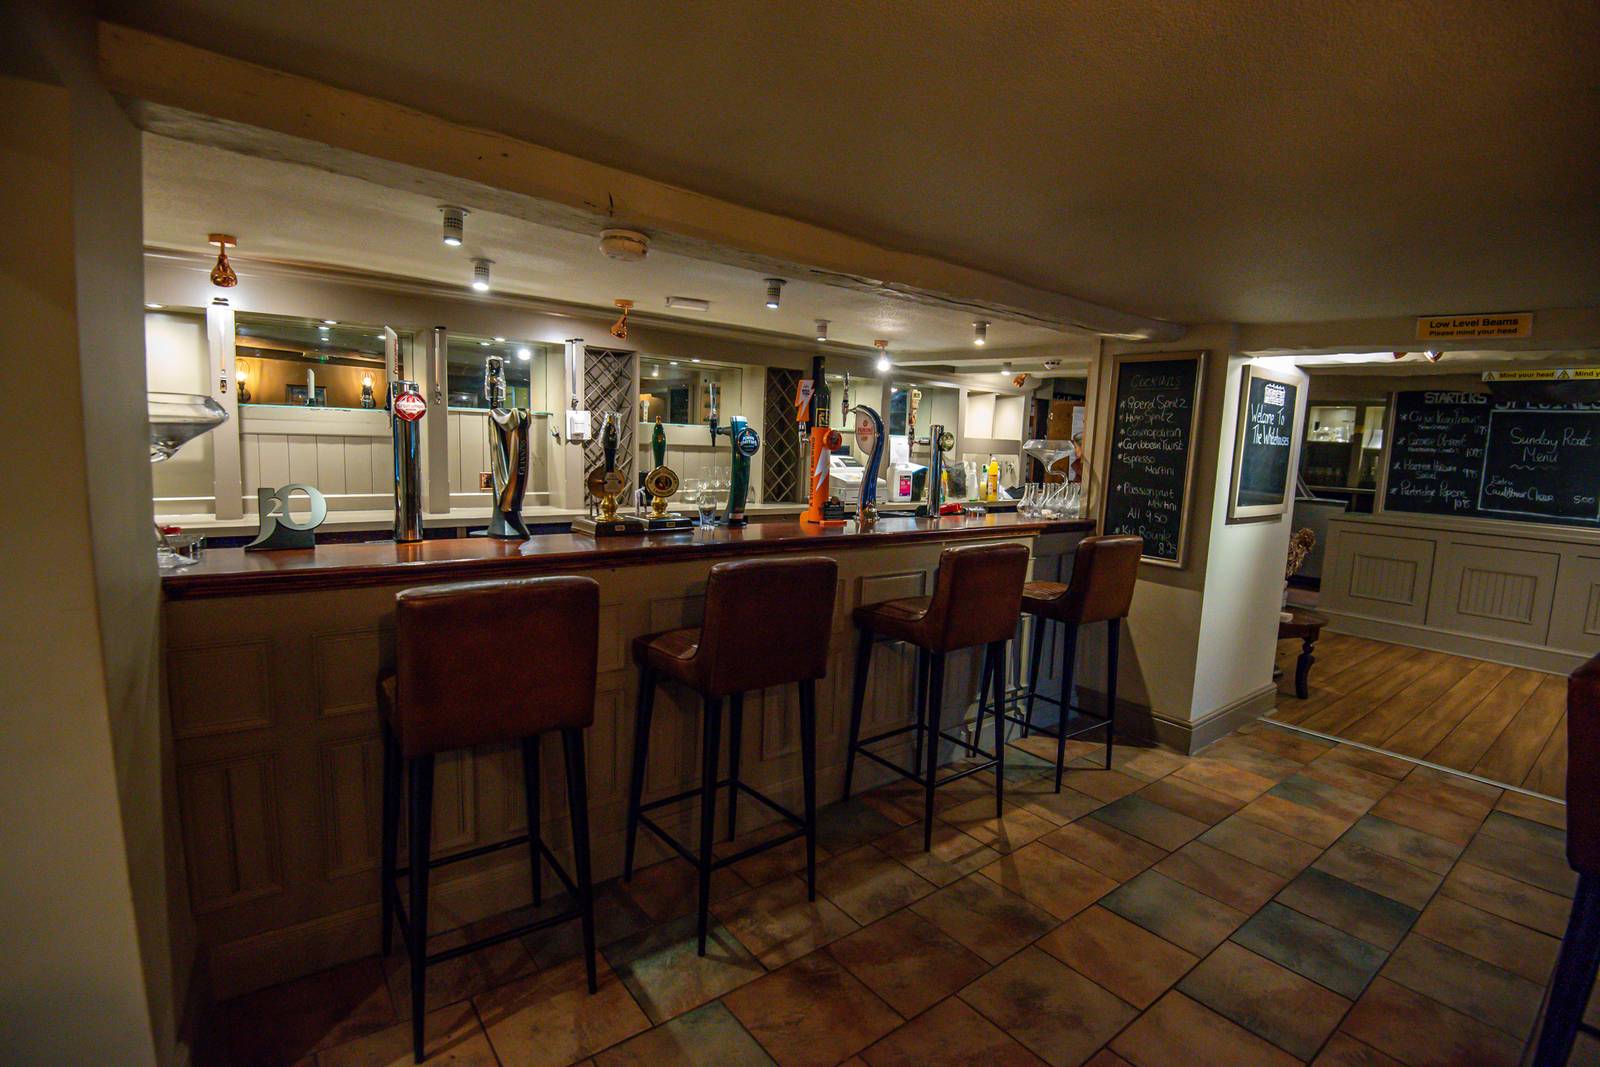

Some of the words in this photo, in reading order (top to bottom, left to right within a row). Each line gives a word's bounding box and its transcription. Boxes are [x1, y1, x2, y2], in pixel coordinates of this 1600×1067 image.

[1430, 320, 1450, 329] Low
[1452, 319, 1479, 328] Level
[1482, 317, 1519, 327] Beams
[1429, 329, 1455, 337] Please
[1497, 327, 1518, 335] head
[1499, 371, 1516, 379] Mind
[1574, 370, 1594, 378] Mind
[1424, 391, 1487, 404] STARTERS
[1251, 403, 1275, 425] Welcome
[1510, 427, 1559, 454] Sunday
[1522, 447, 1559, 463] Menu
[1127, 507, 1141, 519] All
